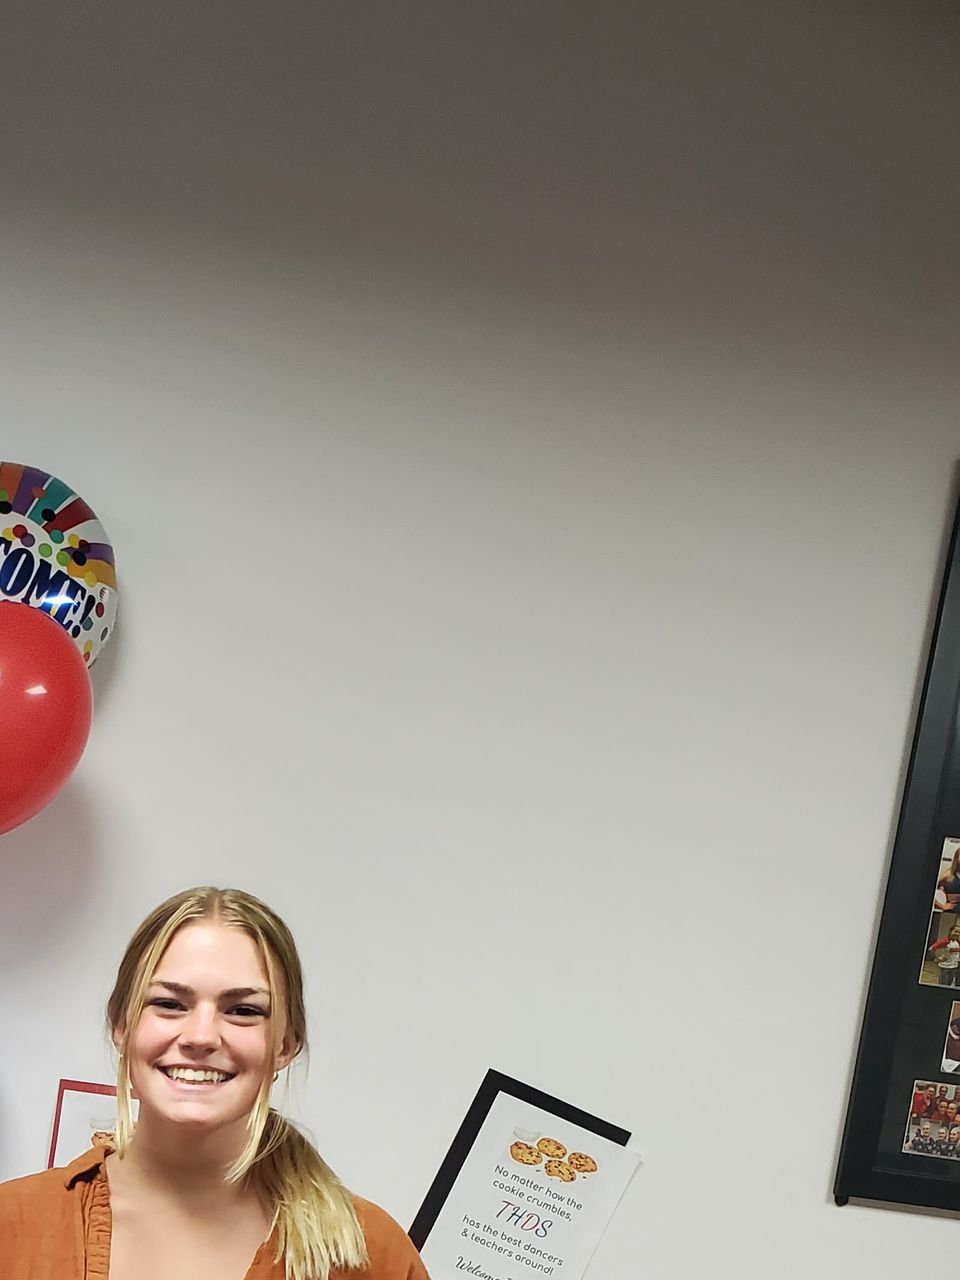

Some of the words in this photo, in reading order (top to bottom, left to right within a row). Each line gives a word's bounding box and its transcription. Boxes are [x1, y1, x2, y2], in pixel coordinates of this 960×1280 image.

[493, 1180, 525, 1198] cookie
[526, 1196, 572, 1222] crumbles,
[495, 1165, 509, 1177] No
[511, 1173, 544, 1191] matter
[545, 1188, 566, 1202] how
[566, 1197, 583, 1211] the
[463, 1215, 480, 1228] has
[483, 1223, 498, 1237] the
[501, 1232, 522, 1247] best
[523, 1243, 563, 1266] dancers
[496, 1200, 553, 1238] THDS
[461, 1228, 468, 1237] &
[471, 1232, 513, 1258] teachers
[515, 1254, 554, 1276] around!
